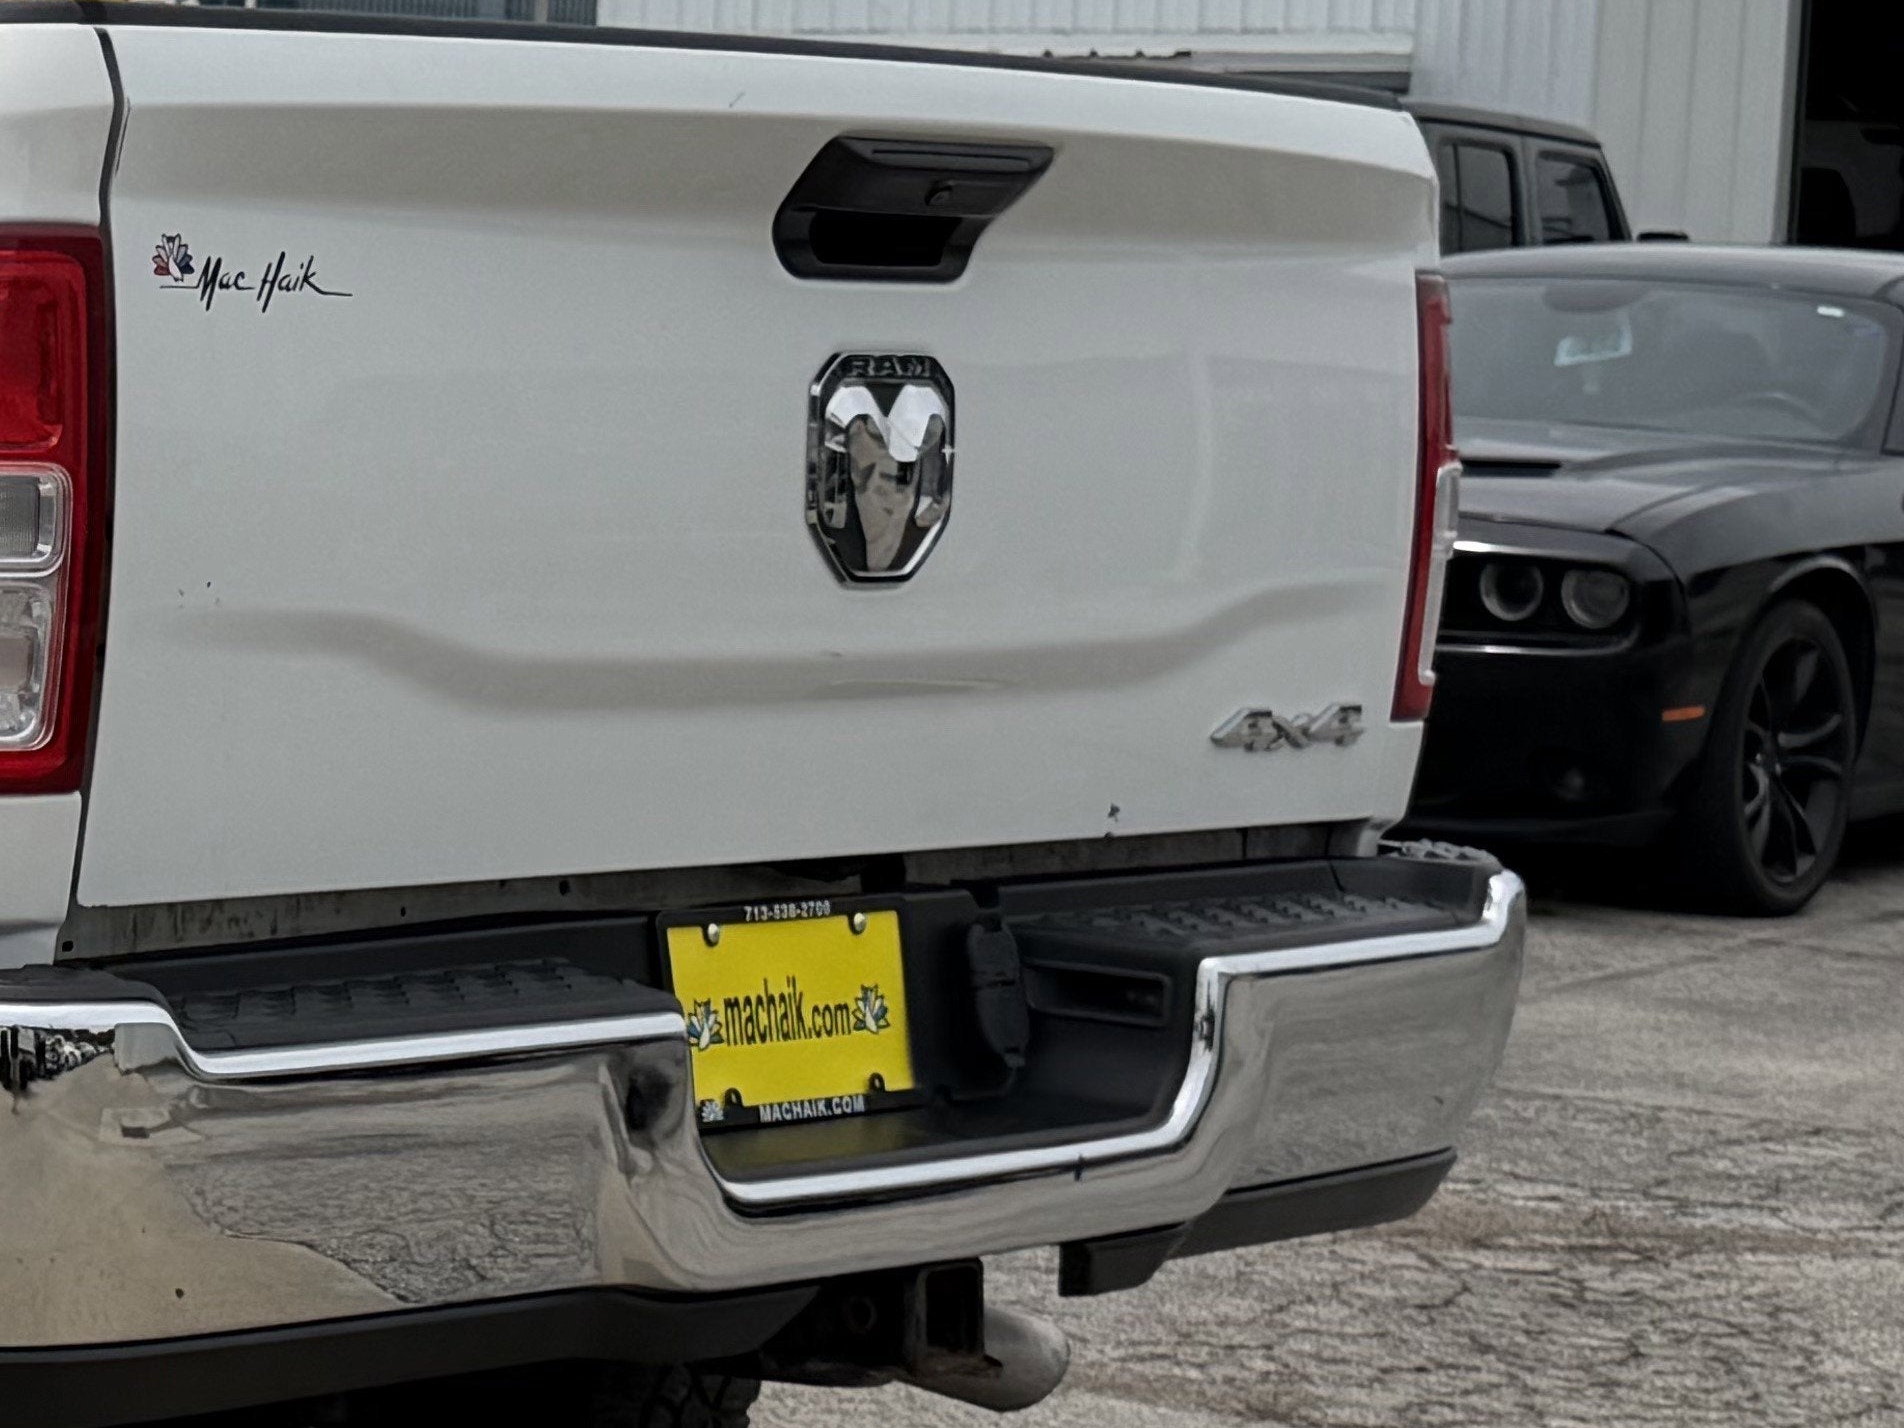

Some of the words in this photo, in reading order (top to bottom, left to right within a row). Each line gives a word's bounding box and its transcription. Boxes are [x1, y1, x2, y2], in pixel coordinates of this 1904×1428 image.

[187, 256, 255, 312] Mac
[256, 250, 340, 314] Haik
[723, 974, 852, 1047] machaik.com
[758, 1093, 866, 1123] MACHAIK.COM
